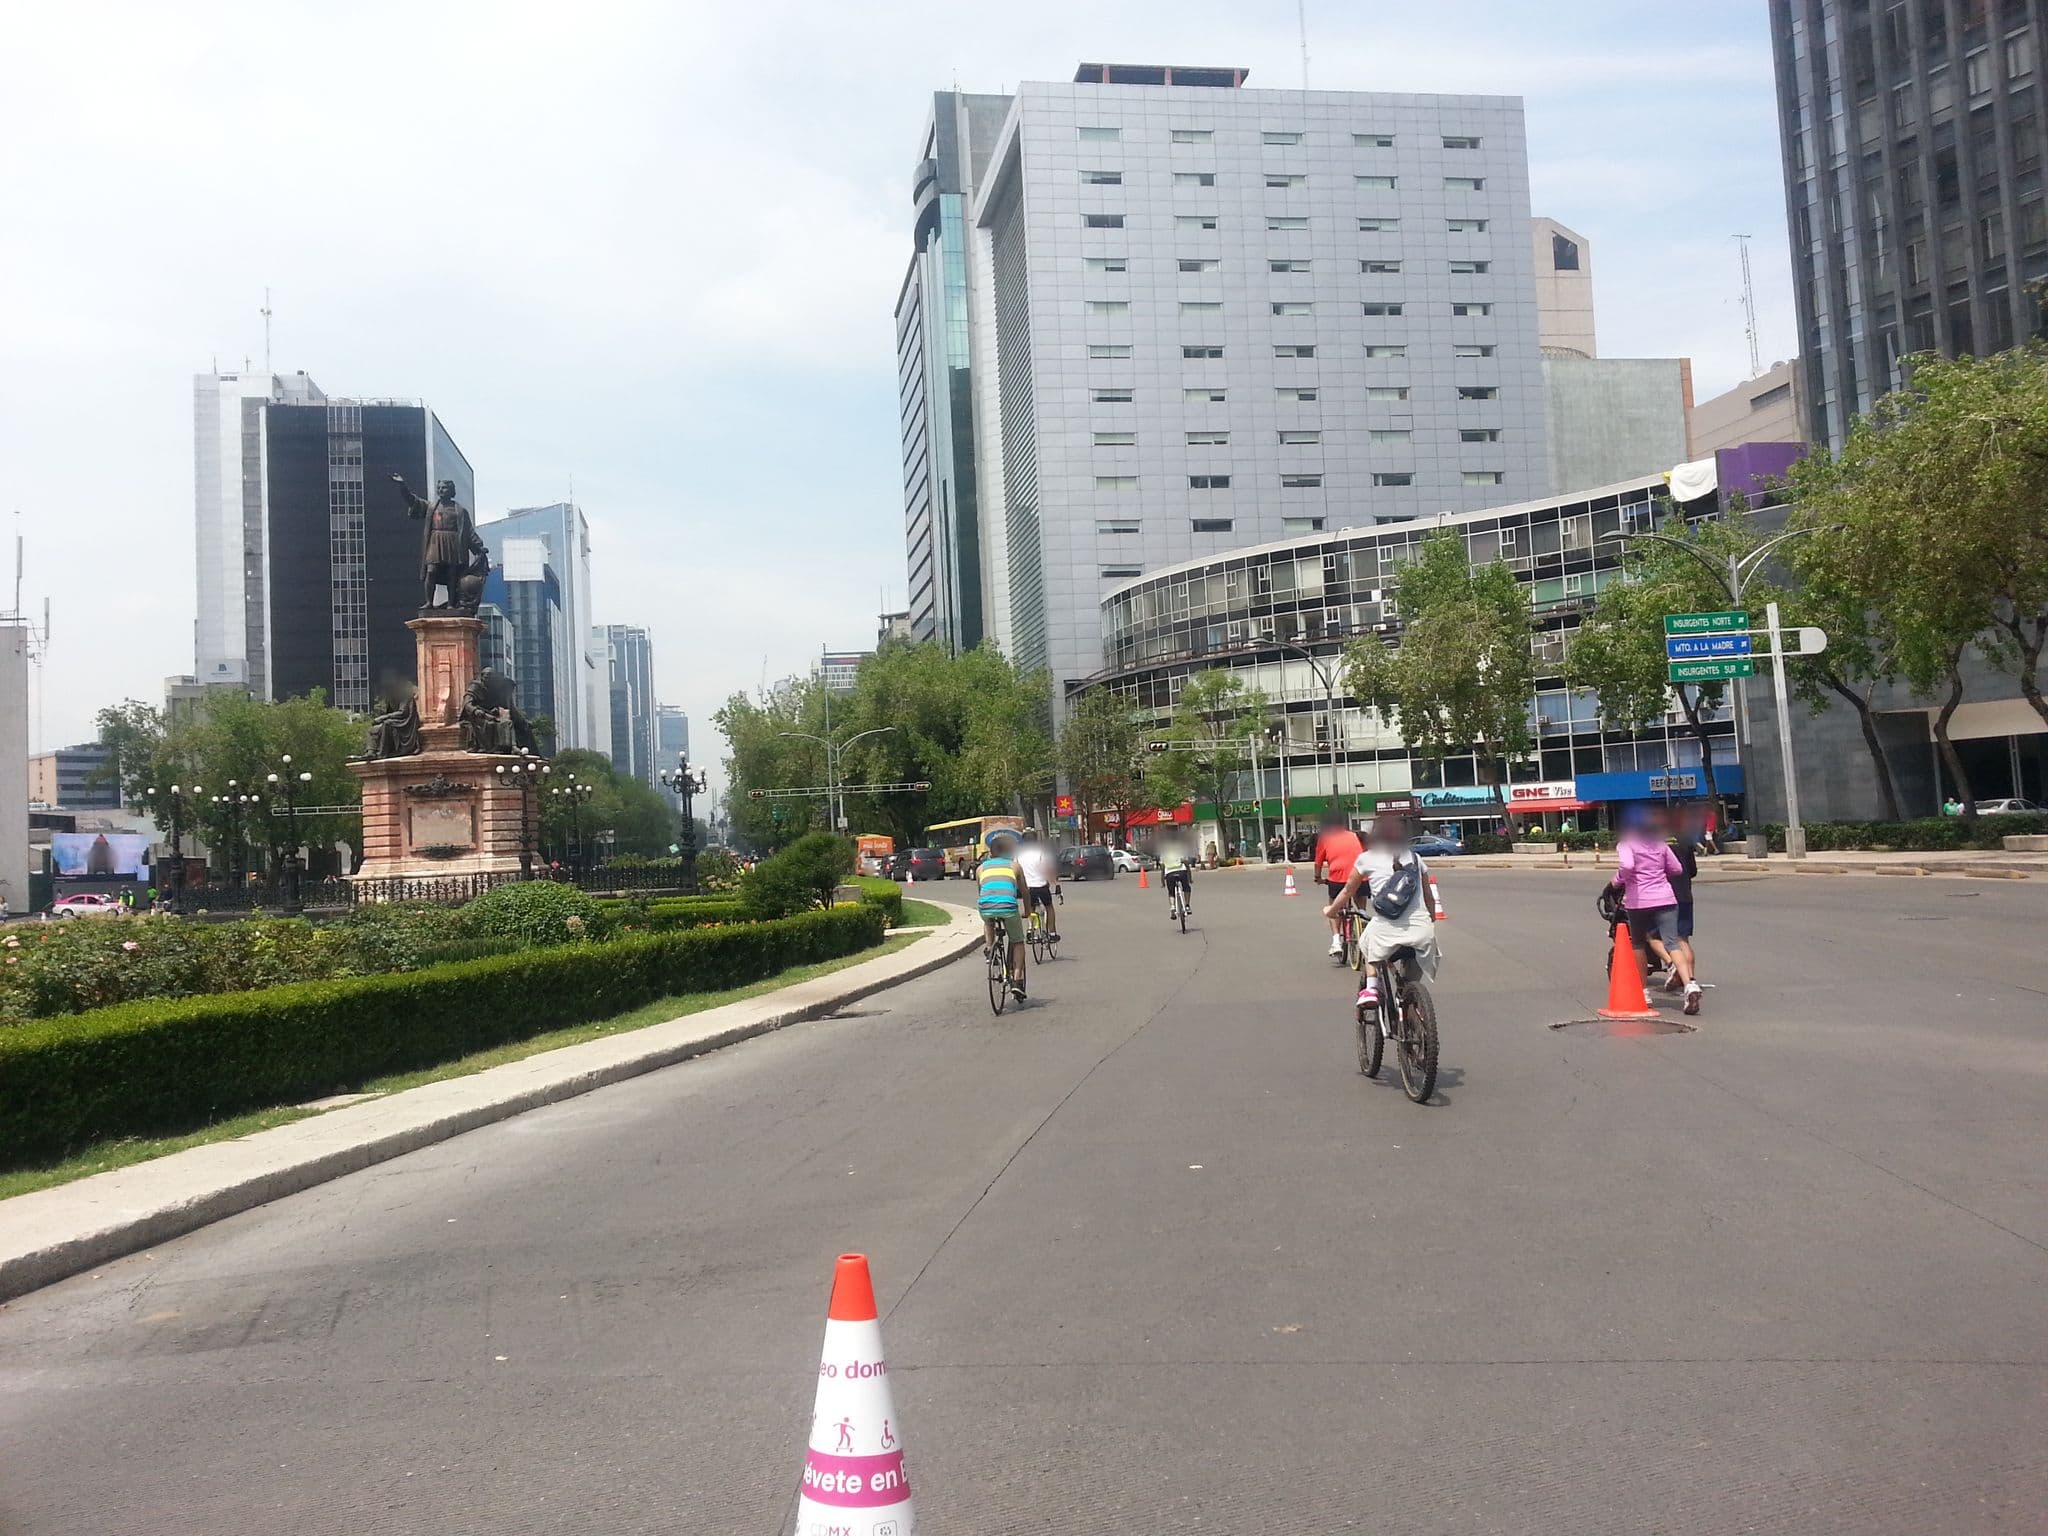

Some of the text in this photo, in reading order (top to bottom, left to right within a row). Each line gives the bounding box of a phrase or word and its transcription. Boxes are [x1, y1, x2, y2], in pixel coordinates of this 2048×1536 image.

[1673, 616, 1732, 628] INSURGENTES NORTE
[1694, 643, 1699, 651] A
[1700, 643, 1709, 651] LA
[1712, 641, 1734, 650] MADRE
[1678, 665, 1736, 676] INSURGENTES SUR
[1512, 787, 1550, 798] GNC
[1234, 804, 1251, 814] ixe
[870, 1468, 897, 1492] en
